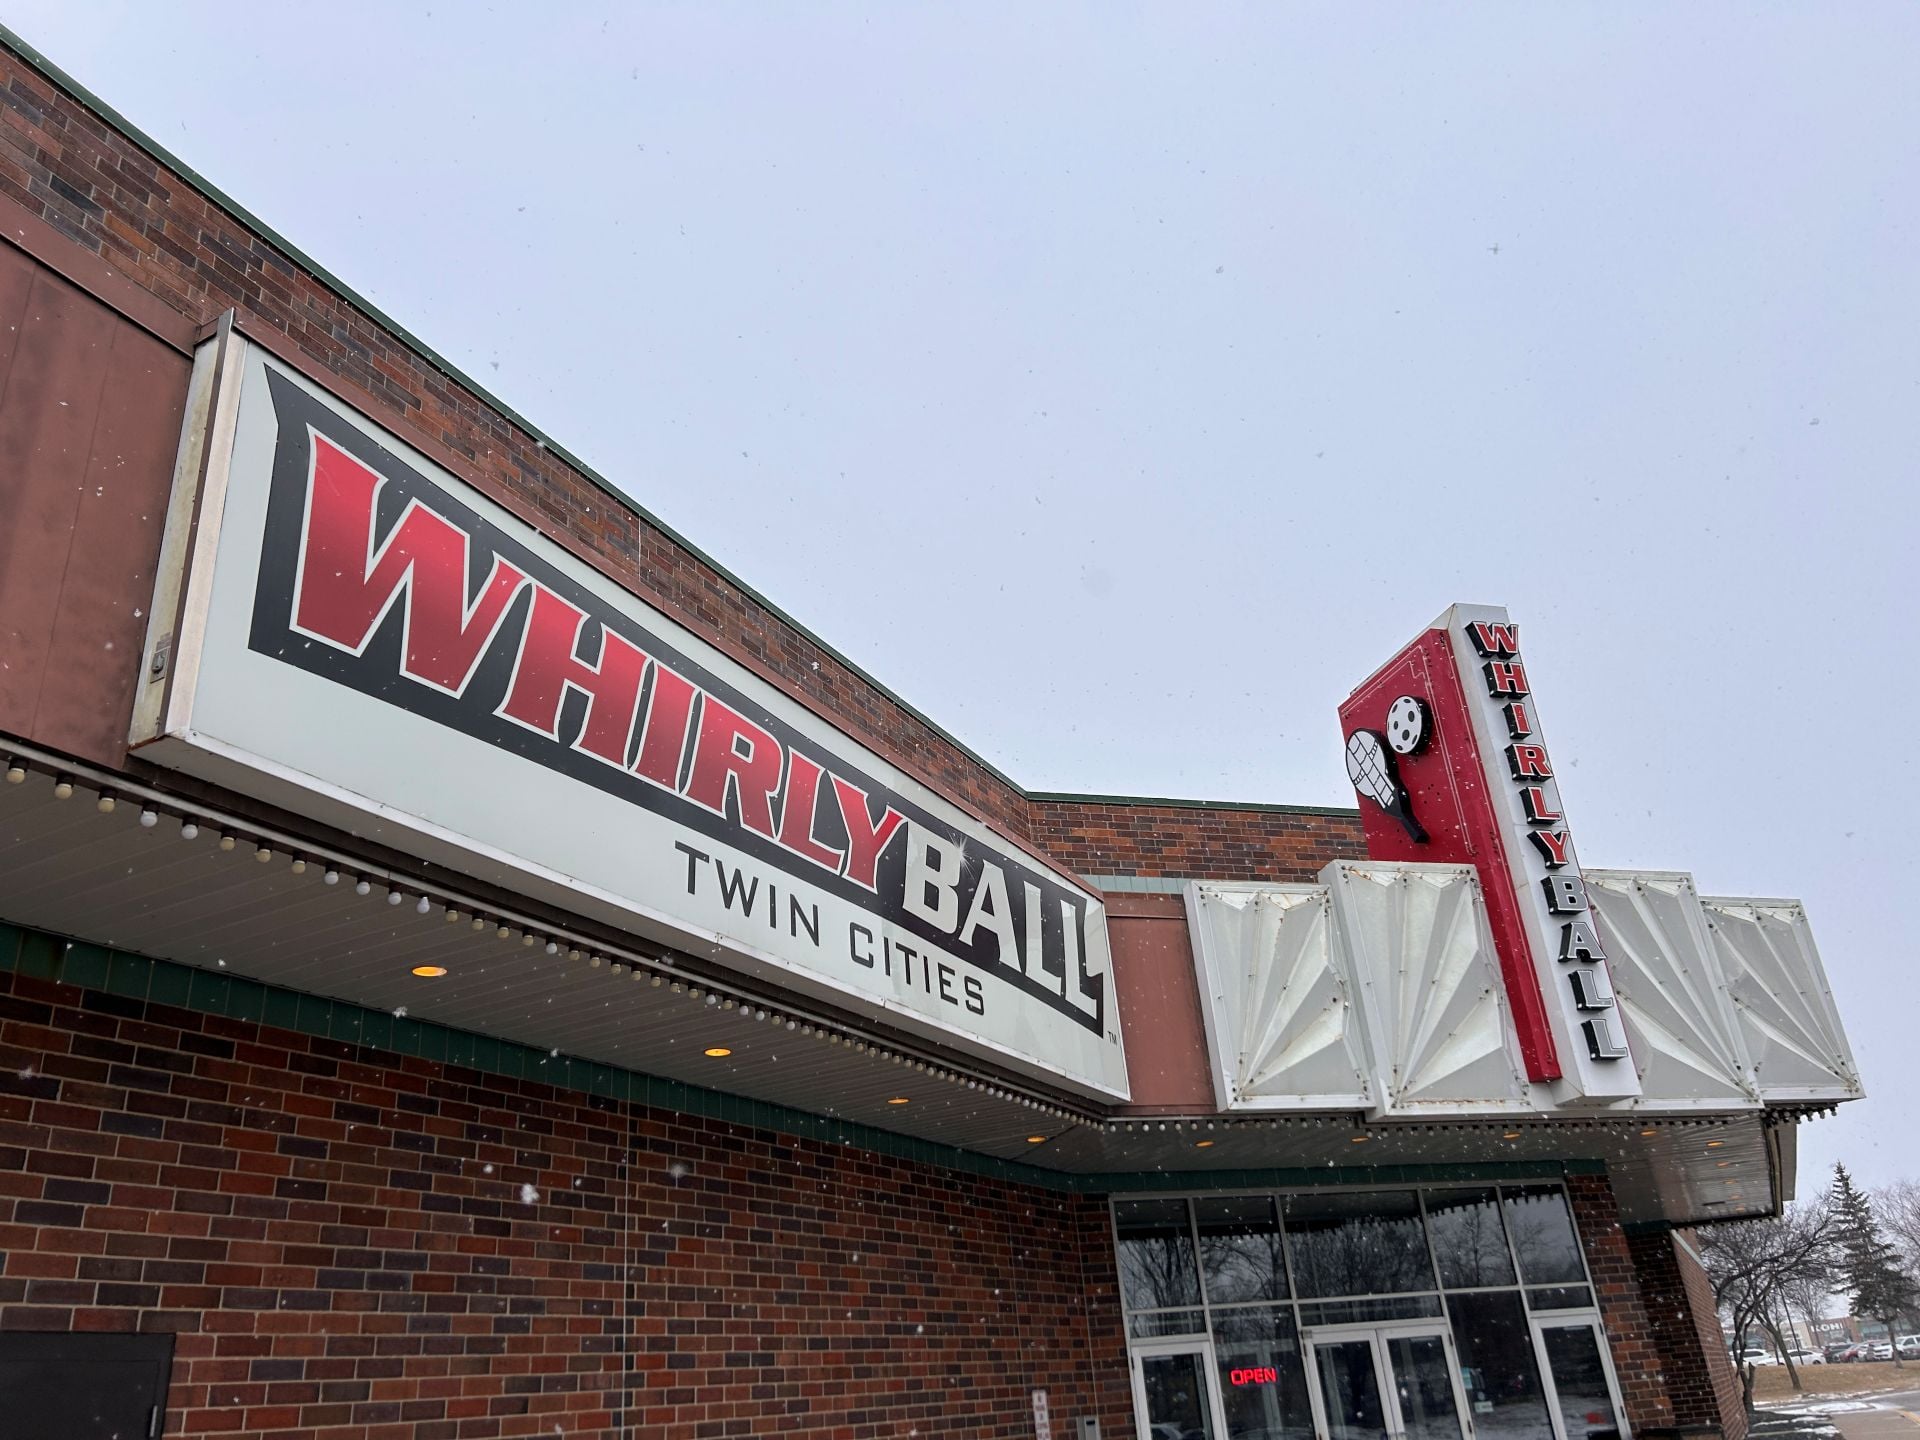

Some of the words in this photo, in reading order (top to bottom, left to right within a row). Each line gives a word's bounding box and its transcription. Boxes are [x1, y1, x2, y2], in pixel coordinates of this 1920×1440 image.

[289, 422, 1098, 1020] WHIRLYBALL
[1466, 621, 1628, 1061] WHIRLYBALL
[674, 840, 820, 947] TWIN
[849, 921, 985, 1016] CITIES
[1230, 1367, 1276, 1385] OPEN
